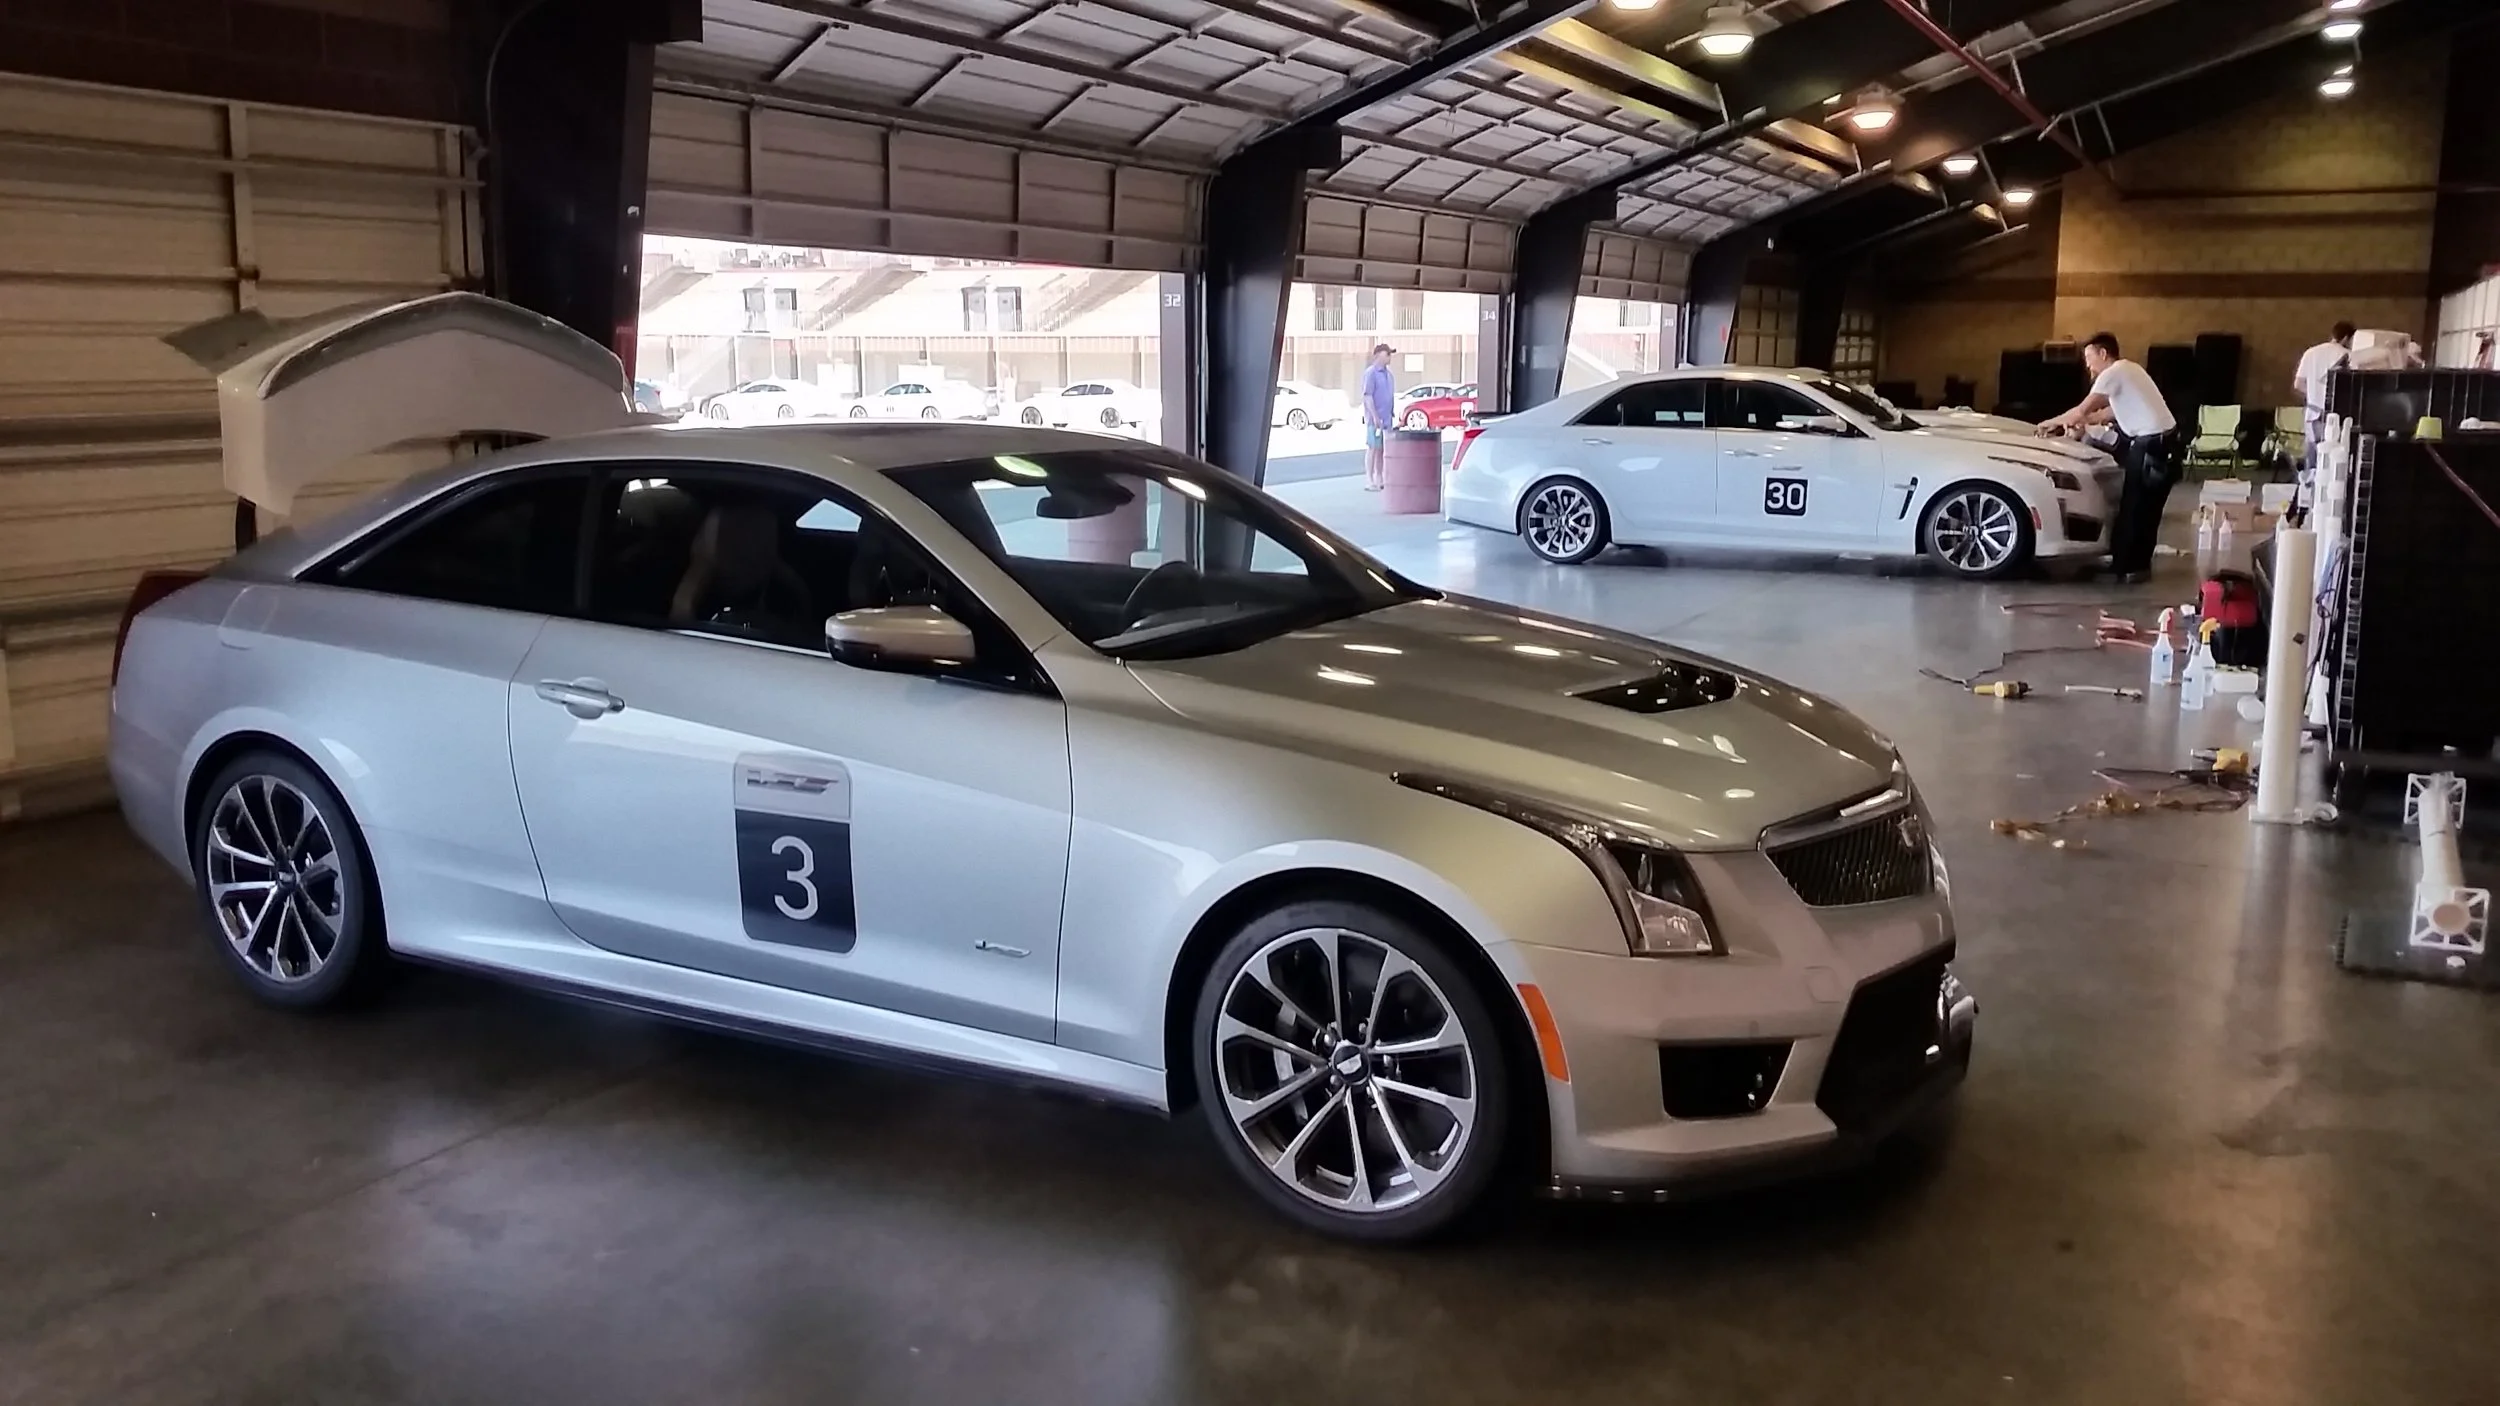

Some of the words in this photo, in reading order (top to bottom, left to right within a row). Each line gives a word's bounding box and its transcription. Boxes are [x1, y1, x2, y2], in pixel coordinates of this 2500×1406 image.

[1163, 293, 1181, 308] 32
[1766, 481, 1805, 510] 30
[771, 835, 819, 921] 3
